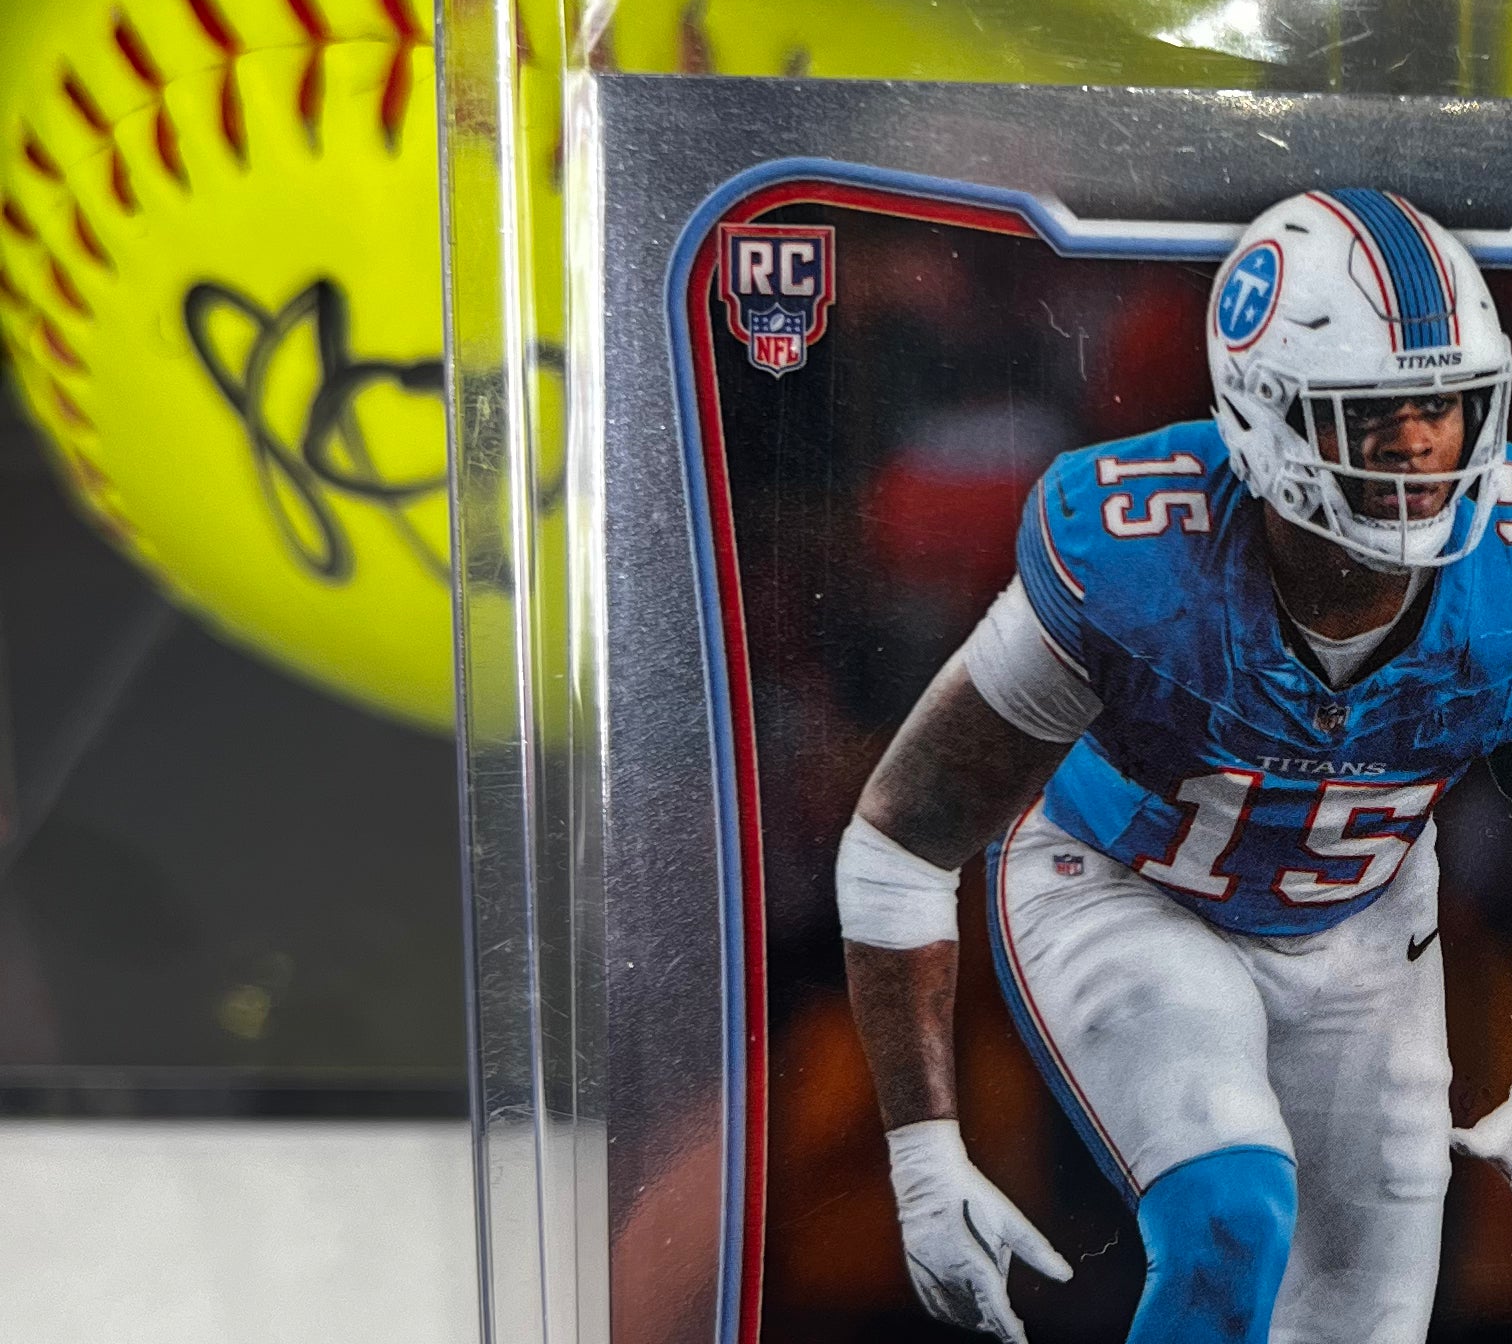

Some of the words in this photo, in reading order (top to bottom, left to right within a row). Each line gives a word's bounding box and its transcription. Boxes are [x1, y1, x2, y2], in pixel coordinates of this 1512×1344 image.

[739, 240, 816, 296] RC
[753, 336, 800, 367] NFL
[1395, 351, 1463, 370] TITANS
[1097, 451, 1212, 538] 15
[1256, 755, 1387, 776] TITANS
[1134, 767, 1448, 907] 15
